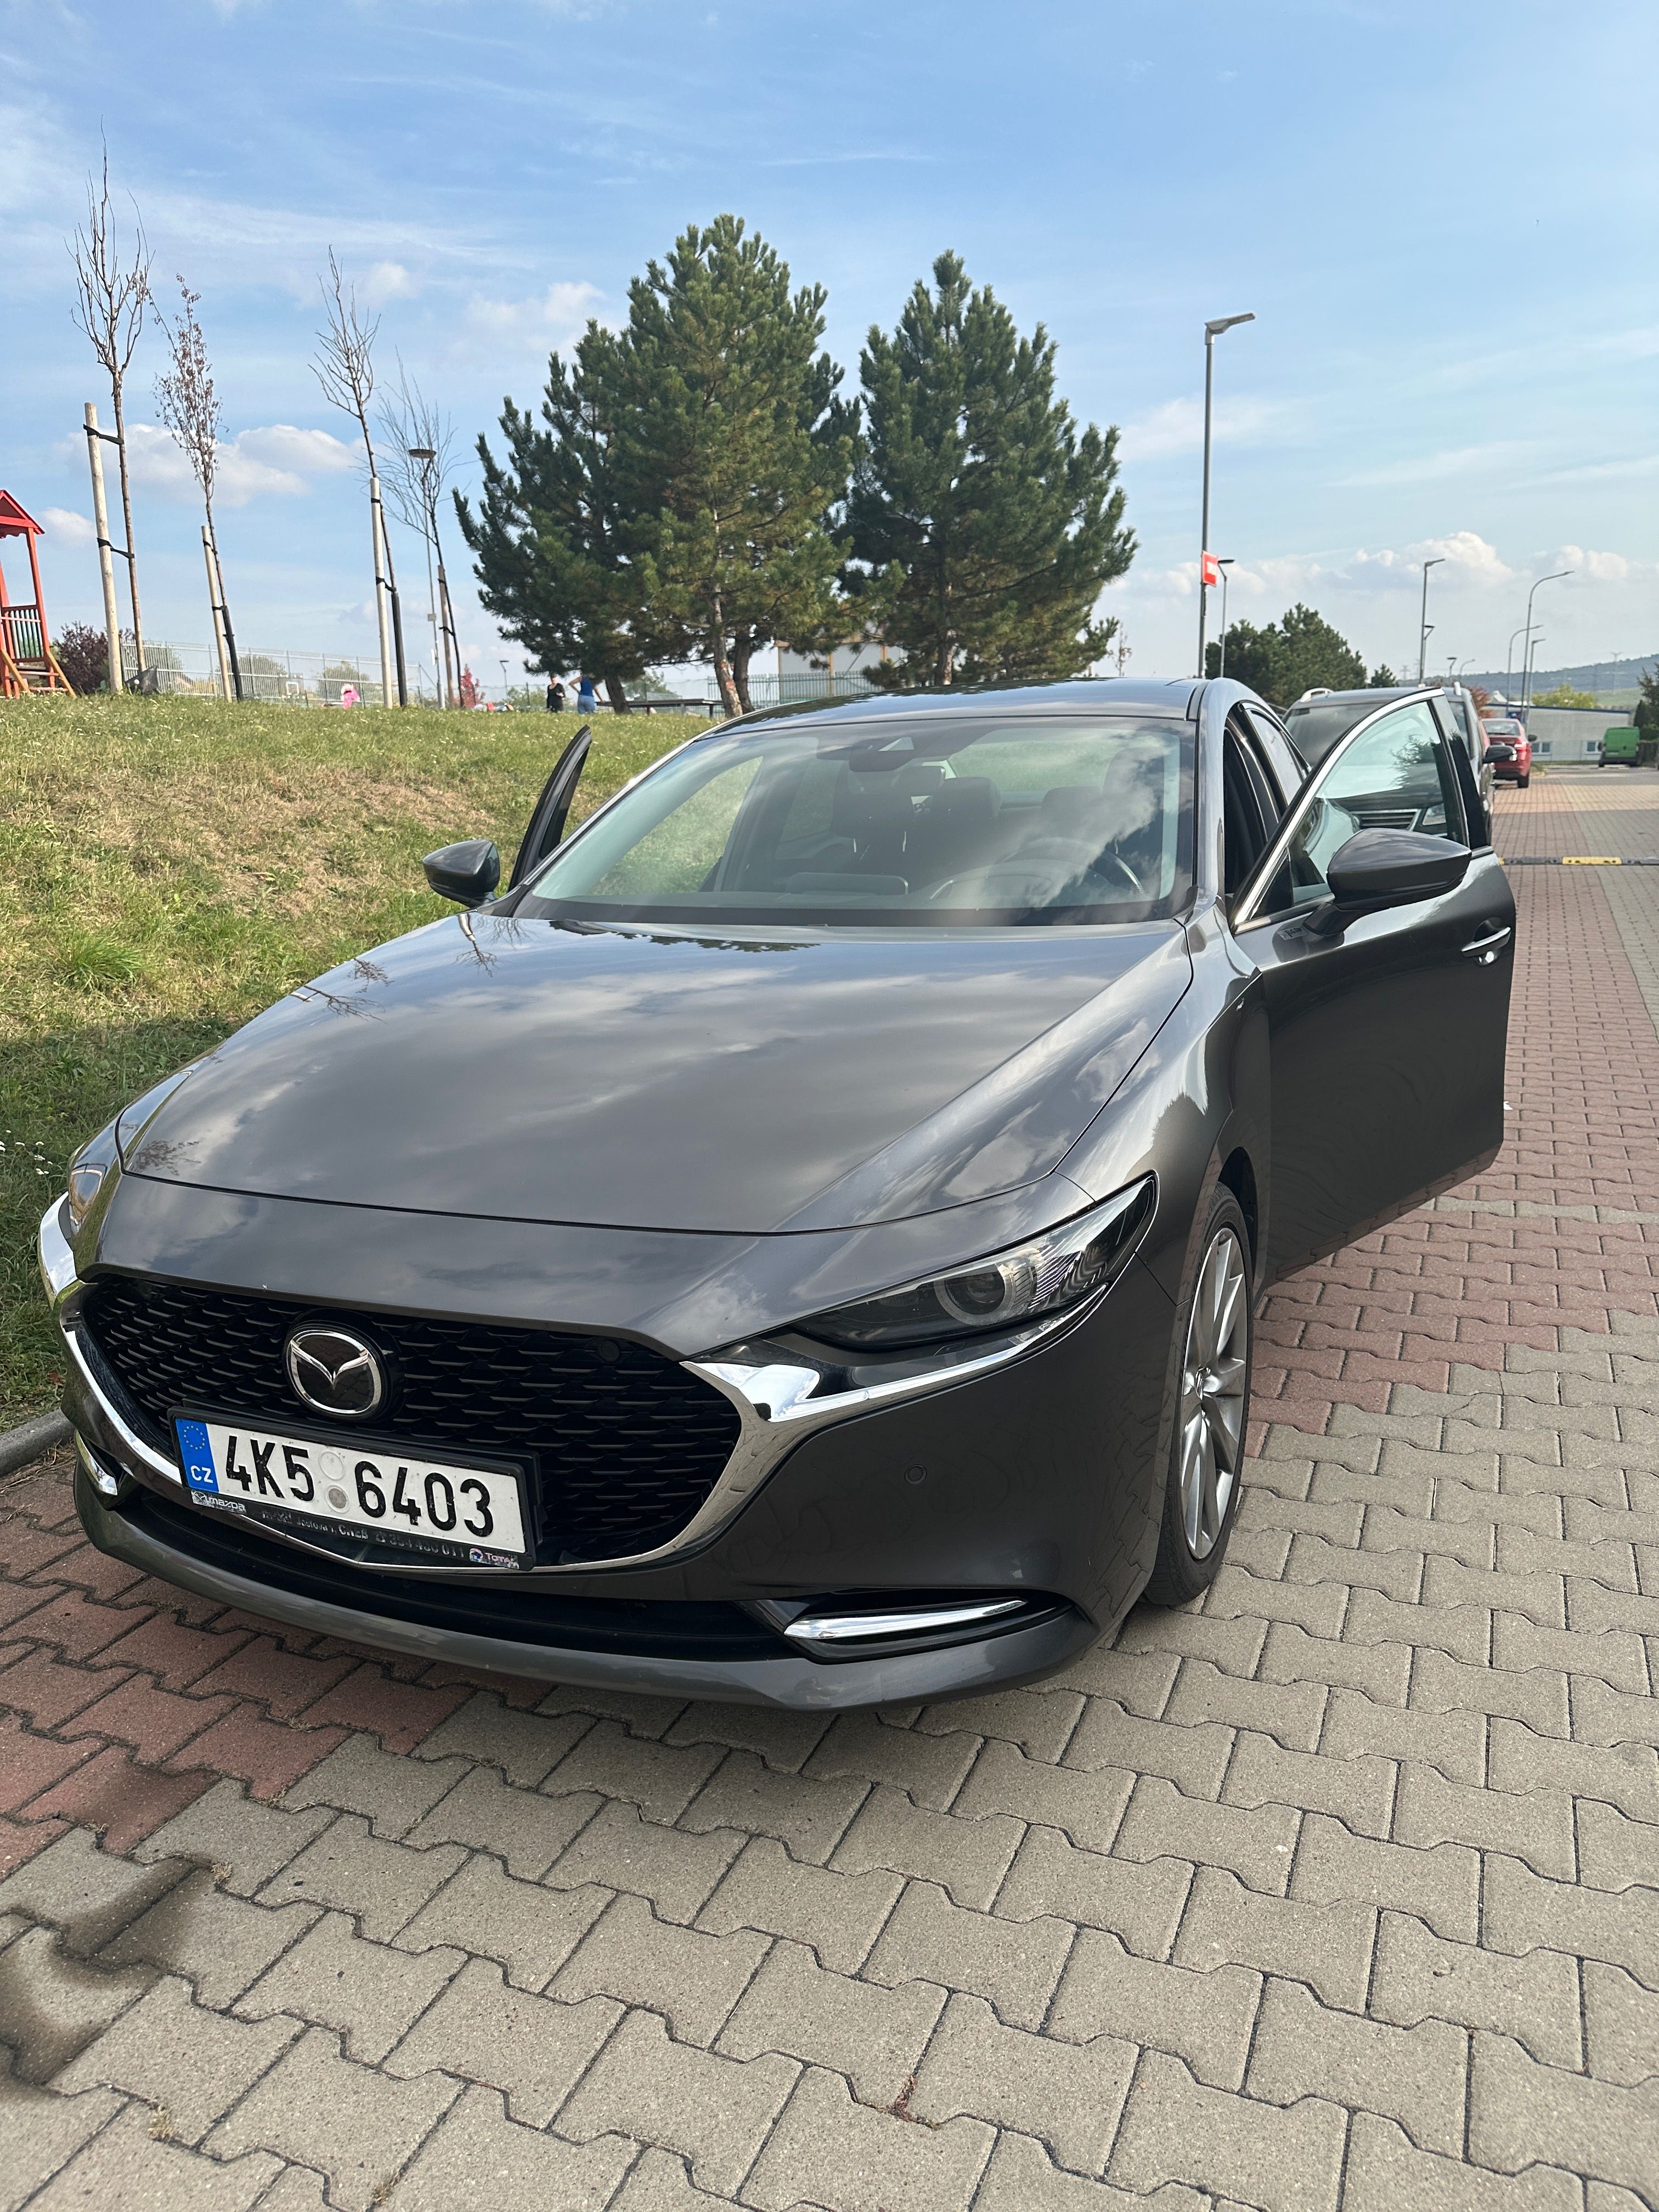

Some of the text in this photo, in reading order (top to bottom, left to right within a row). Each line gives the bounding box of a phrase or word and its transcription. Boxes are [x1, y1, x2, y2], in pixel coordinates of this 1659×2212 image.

[191, 1465, 213, 1483] CZ
[225, 1435, 494, 1537] 4K5 6403
